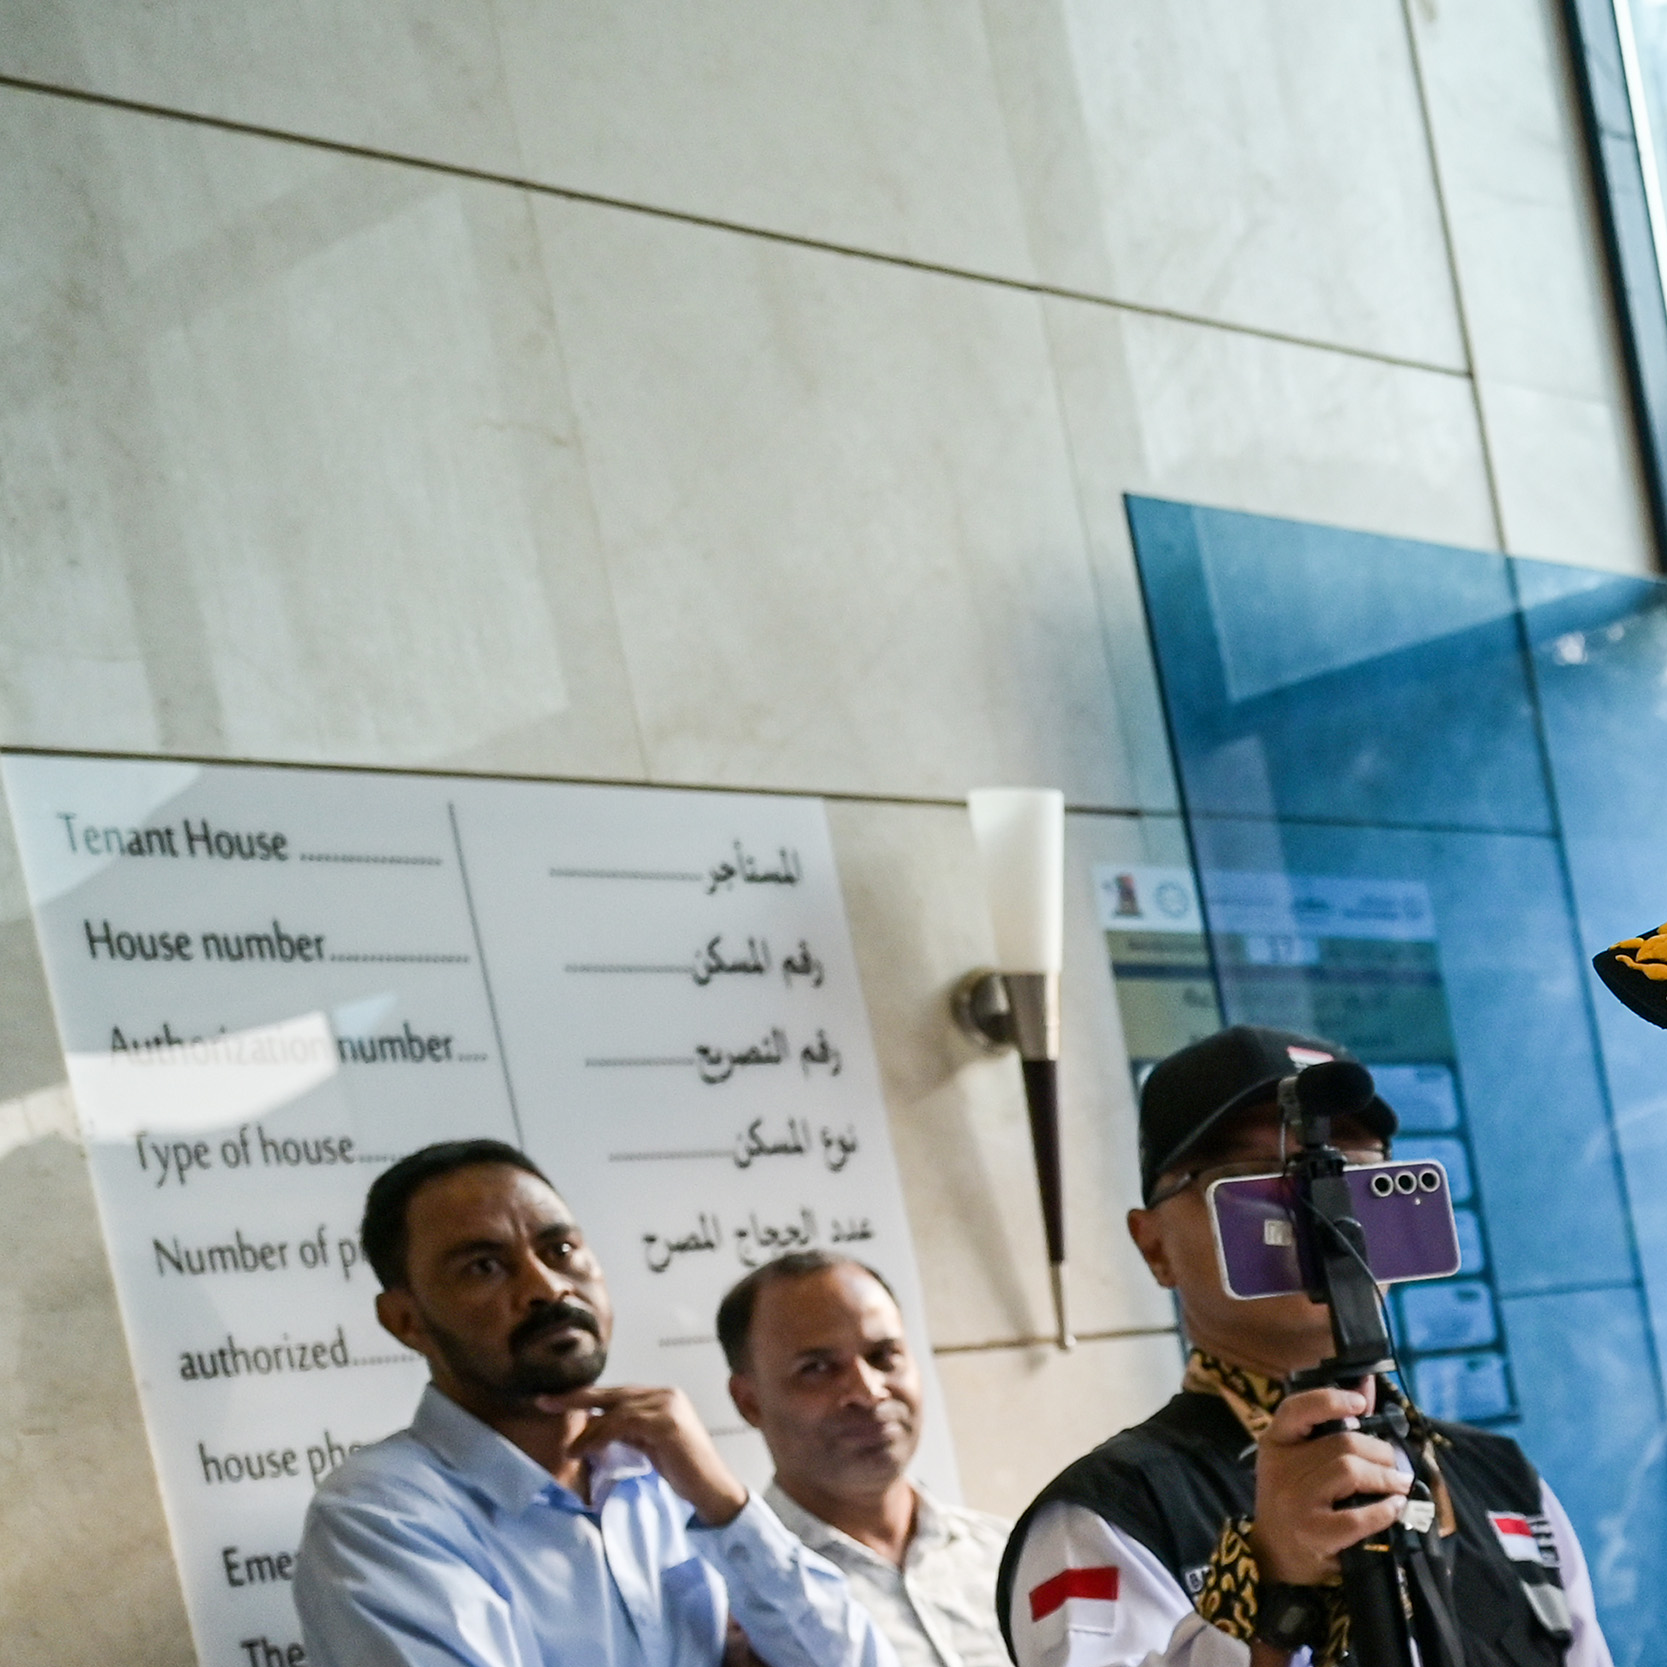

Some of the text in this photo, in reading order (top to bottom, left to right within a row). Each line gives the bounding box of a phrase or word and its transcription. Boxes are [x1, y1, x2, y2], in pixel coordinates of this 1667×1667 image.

[56, 812, 288, 861] Tenant House
[83, 916, 326, 963] House number
[693, 934, 825, 989] رقم المسكن
[111, 1019, 455, 1067] Authorization number
[801, 1028, 842, 1078] رقم
[134, 1122, 357, 1188] Type of house
[735, 1115, 811, 1169] المسكن
[152, 1226, 288, 1277] Number
[298, 1222, 328, 1269] of
[179, 1323, 348, 1381] authorized
[198, 1440, 299, 1486] house
[221, 1545, 299, 1588] Eme
